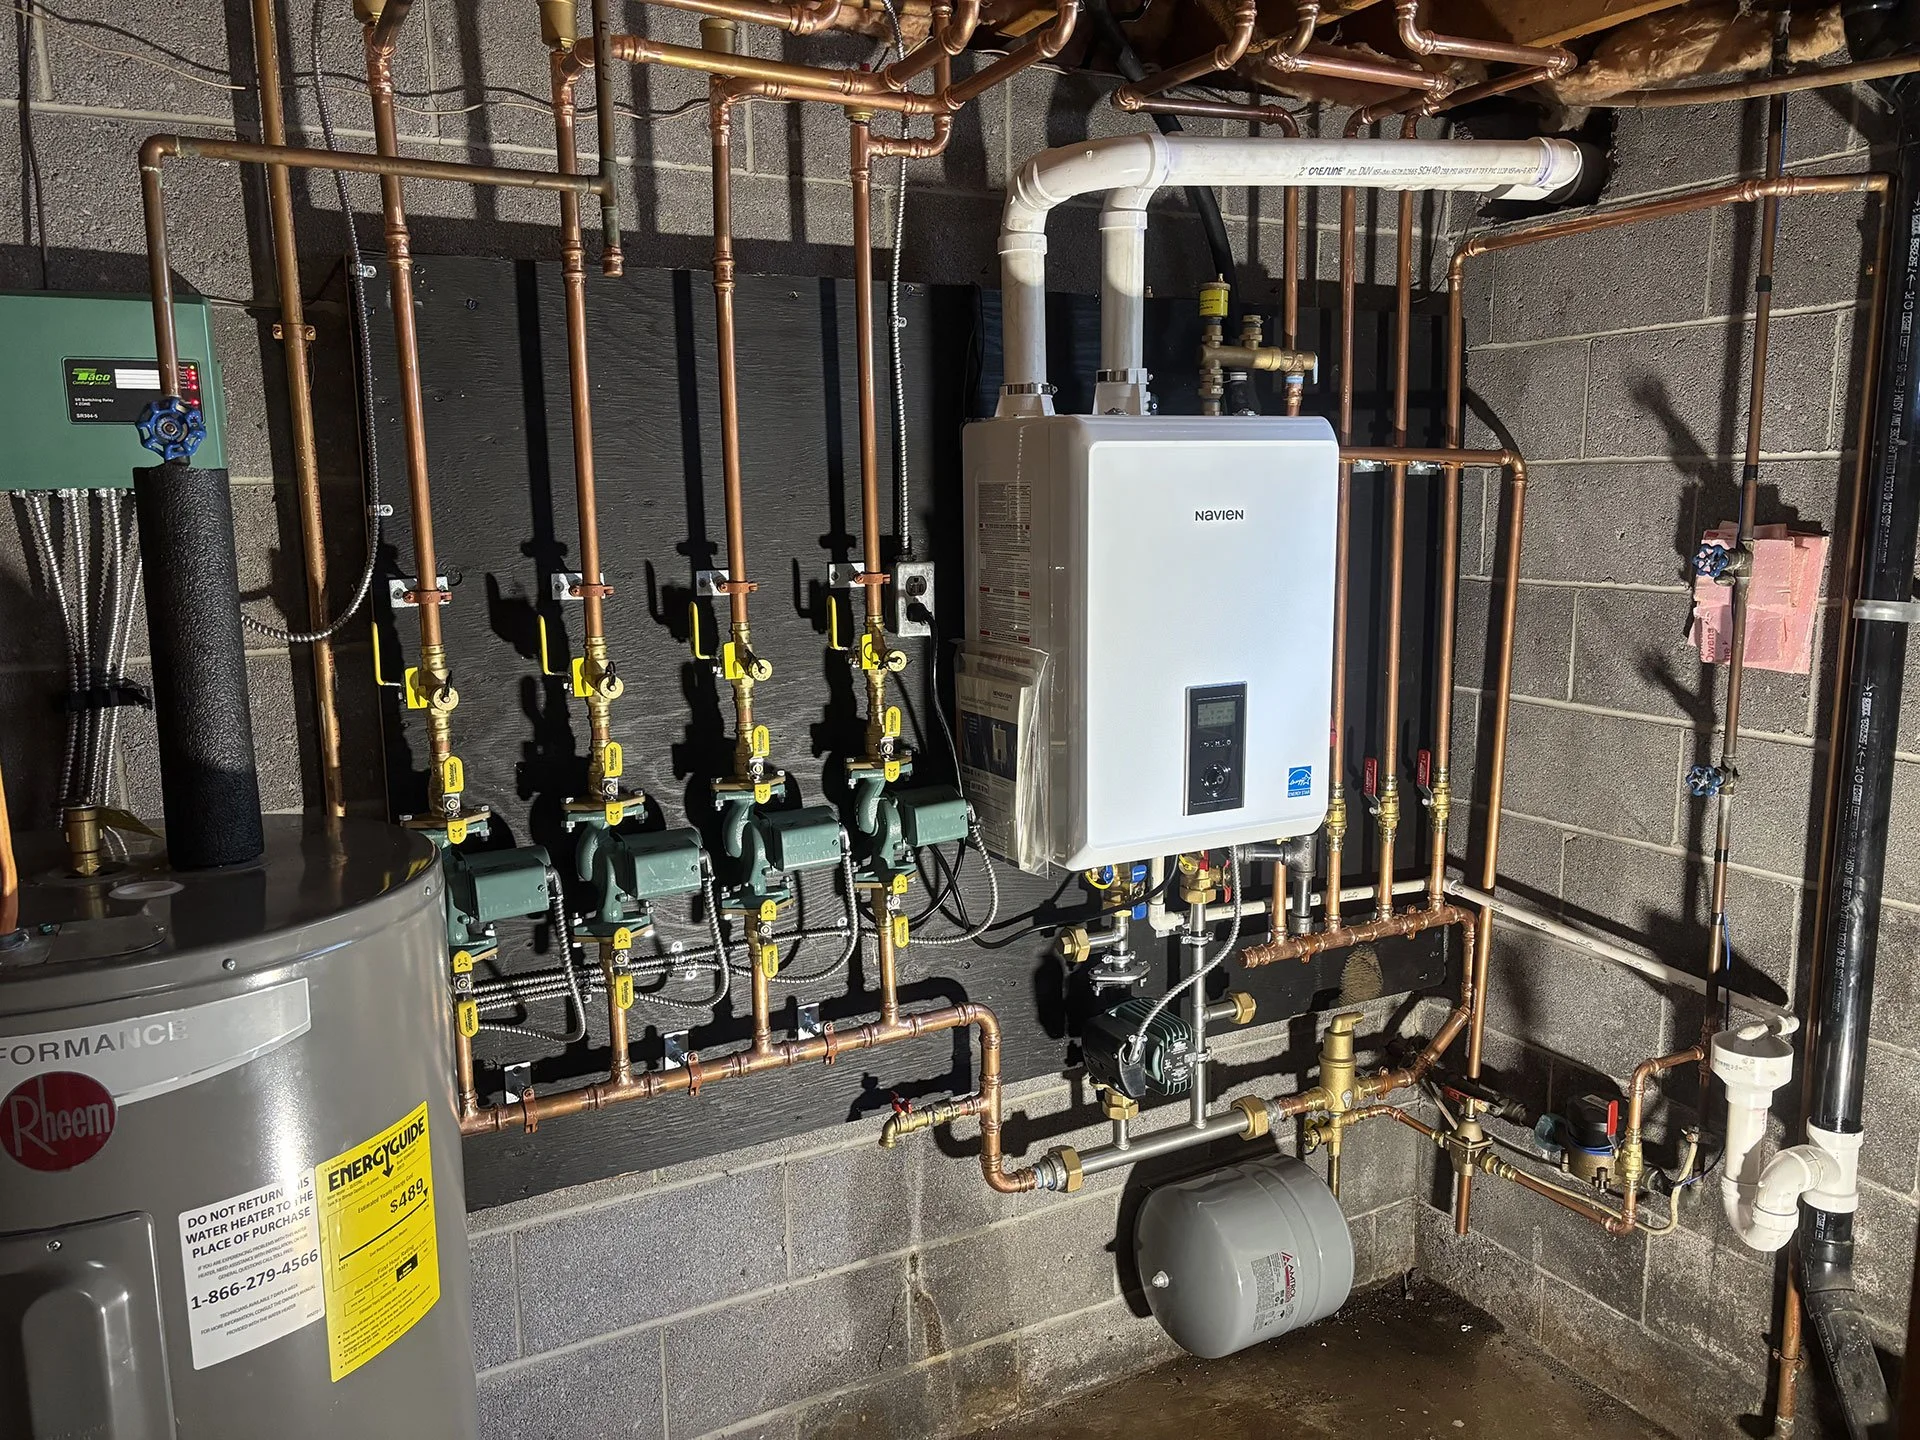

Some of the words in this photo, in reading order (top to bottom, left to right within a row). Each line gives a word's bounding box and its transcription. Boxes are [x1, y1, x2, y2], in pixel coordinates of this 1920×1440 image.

[1358, 166, 1374, 176] DWV
[1419, 166, 1432, 175] SCH
[1432, 166, 1441, 175] 40
[72, 368, 110, 381] Taco
[1882, 502, 1892, 514] SCH
[1706, 628, 1714, 662] Owens
[10, 1074, 110, 1157] Rheem
[328, 1115, 425, 1192] ENERGYGUIDE
[187, 1214, 207, 1228] DO
[210, 1205, 236, 1221] NOT
[238, 1187, 284, 1212] RETURN
[390, 1178, 423, 1214] $489
[186, 1224, 228, 1244] WATER
[230, 1207, 274, 1230] HEATER
[276, 1200, 291, 1213] TO
[192, 1238, 231, 1258] PLACE
[234, 1232, 250, 1244] OF
[252, 1207, 311, 1238] PURCHASE
[191, 1249, 318, 1310] 1-866-279-4566
